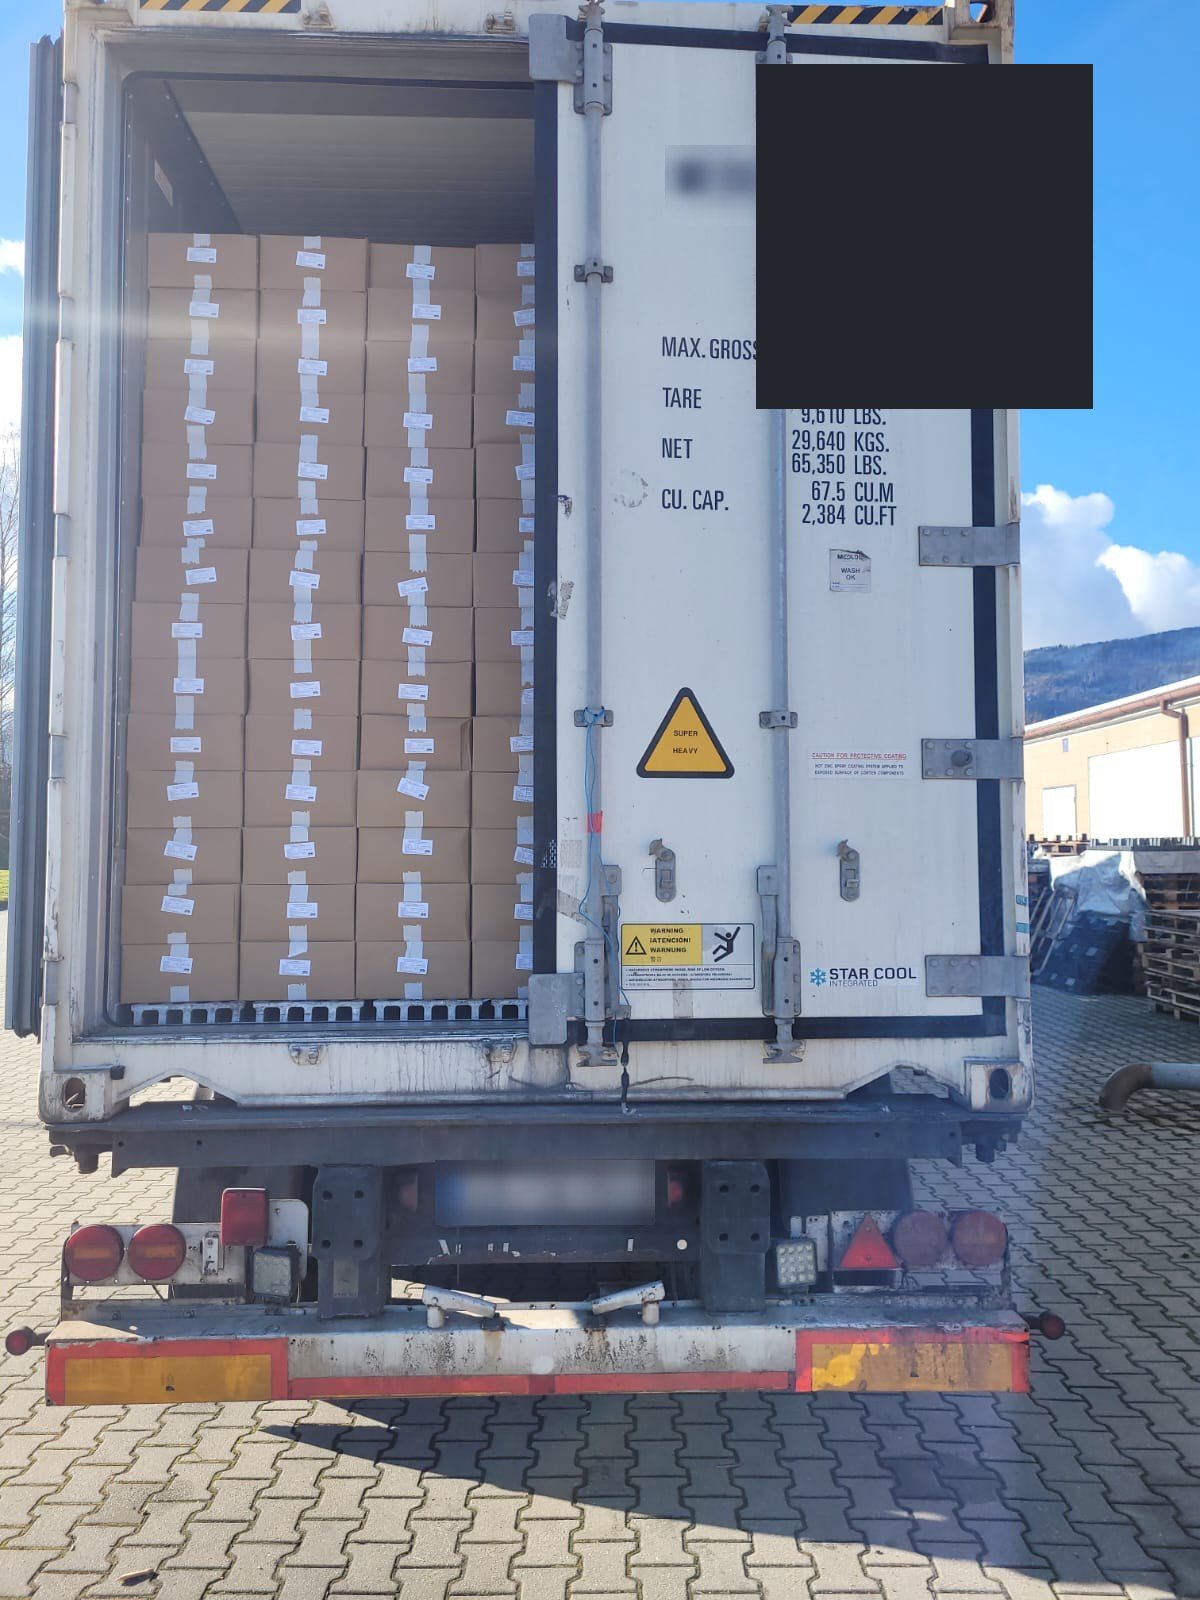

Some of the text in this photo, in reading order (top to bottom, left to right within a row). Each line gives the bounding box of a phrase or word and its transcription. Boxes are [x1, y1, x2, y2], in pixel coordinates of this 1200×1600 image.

[662, 336, 706, 358] MAX.
[662, 387, 702, 409] TARE
[801, 408, 886, 426] 9,610 LBS.
[662, 437, 694, 459] NET
[792, 429, 890, 452] 29,640 KGS.
[792, 452, 887, 475] 65,350 LBS.
[661, 488, 729, 511] CU. CAP.
[811, 480, 894, 503] 67.5 CU.M
[802, 503, 897, 526] 2,384 CU.FT
[829, 967, 917, 980] STAR COOL
